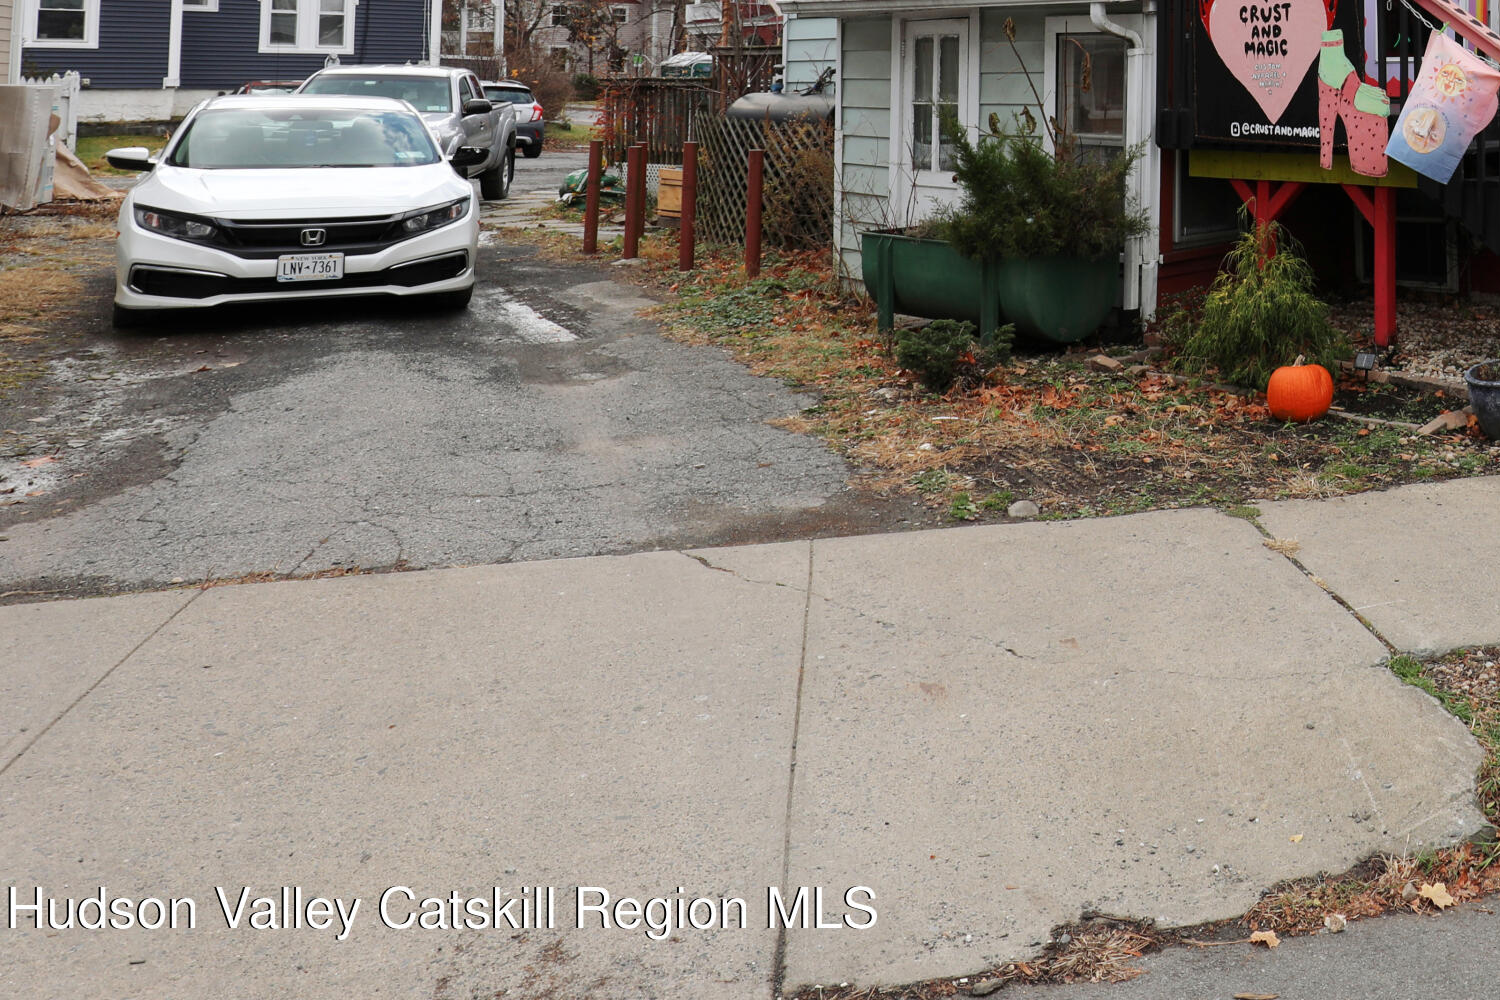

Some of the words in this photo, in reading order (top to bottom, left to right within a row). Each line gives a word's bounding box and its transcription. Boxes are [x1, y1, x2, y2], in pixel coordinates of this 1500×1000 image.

[1240, 3, 1291, 24] CRUST
[1251, 25, 1282, 40] AND
[1244, 39, 1288, 58] MAGIC
[1242, 122, 1320, 138] @CRUSTANDMAGIC
[283, 262, 303, 275] LNV
[312, 260, 337, 274] 7361
